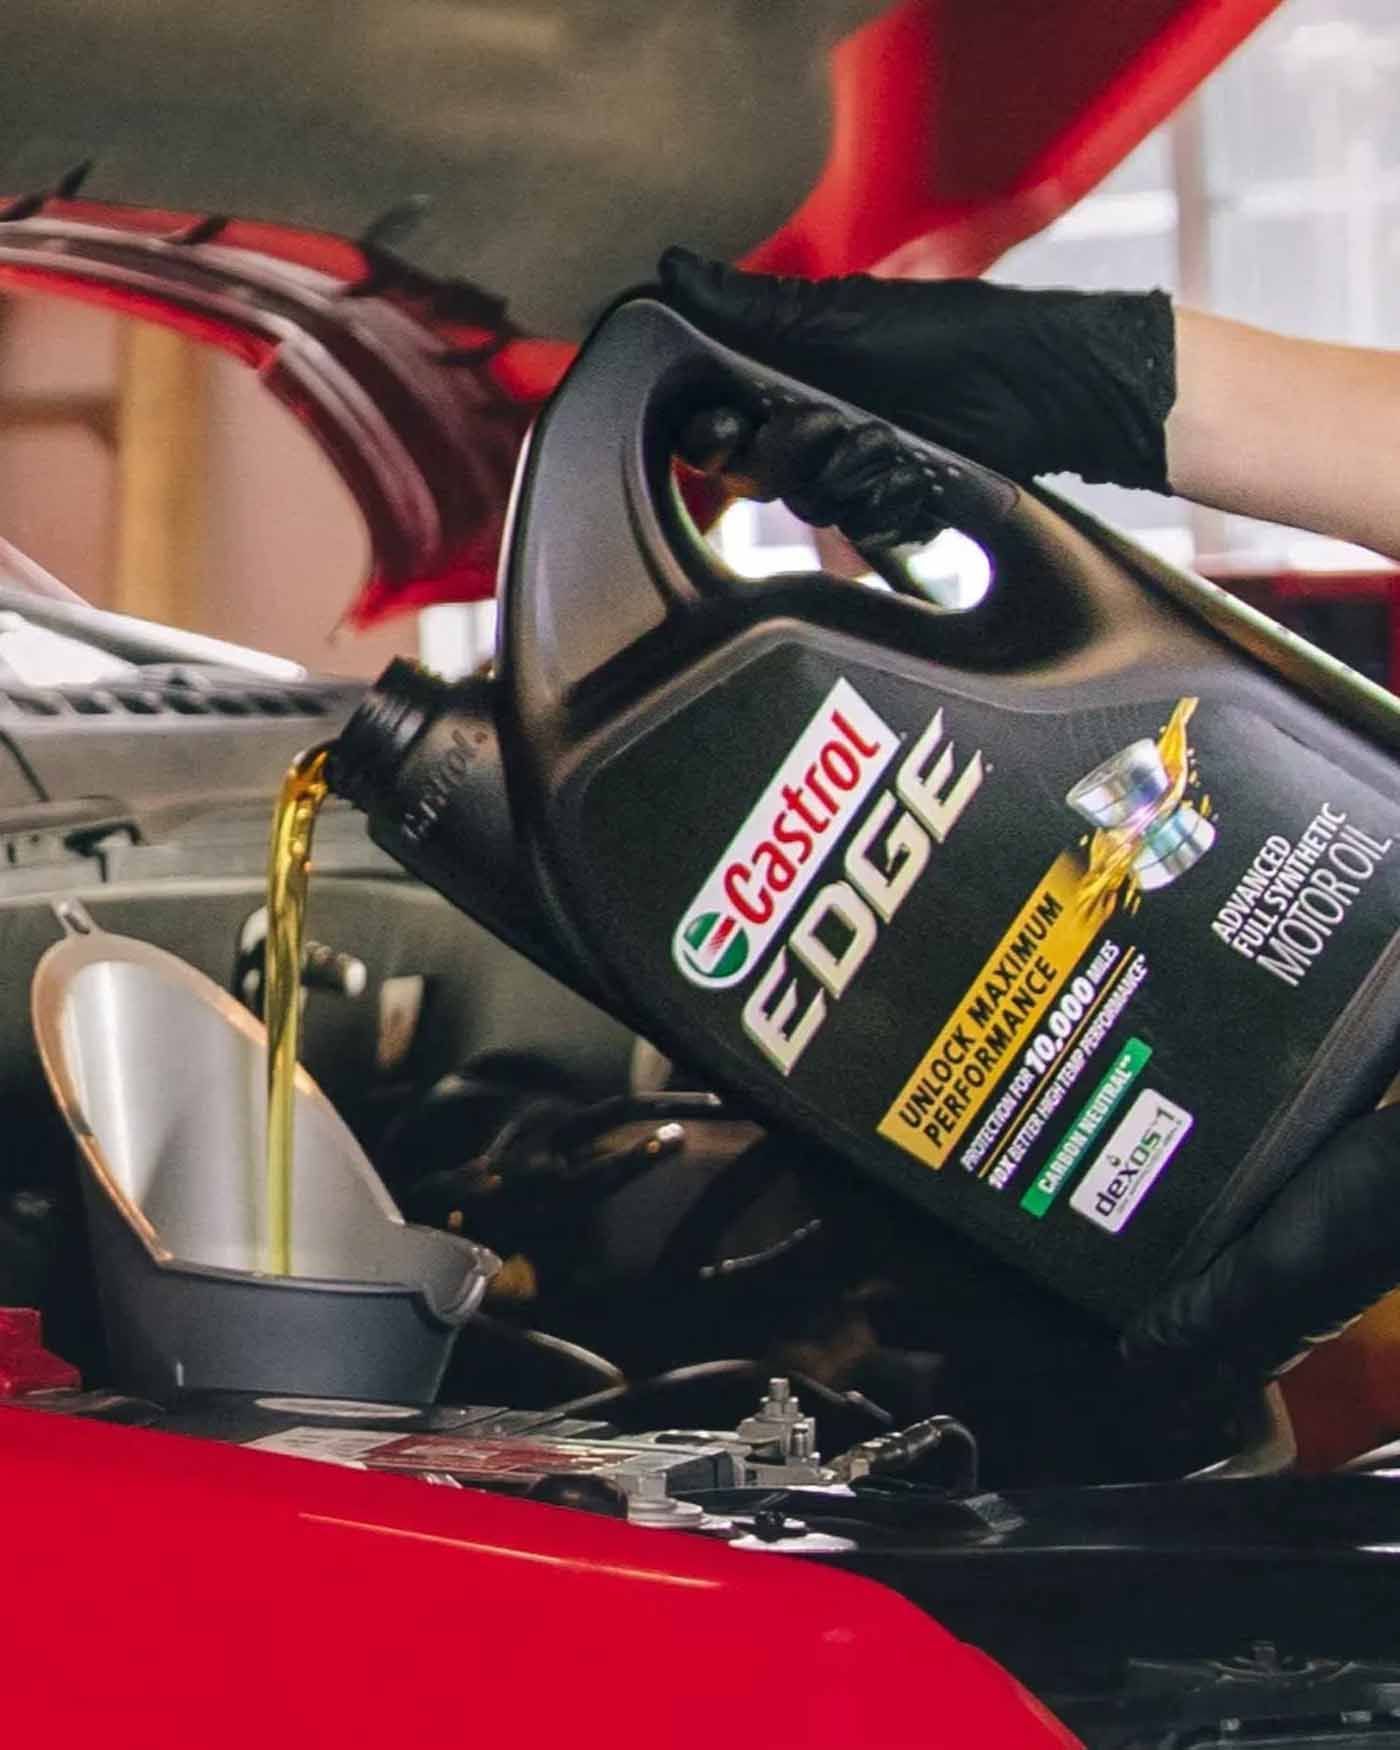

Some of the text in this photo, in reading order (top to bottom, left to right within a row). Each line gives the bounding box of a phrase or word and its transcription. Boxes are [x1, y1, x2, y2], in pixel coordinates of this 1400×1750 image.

[723, 709, 880, 925] Castrol
[741, 706, 984, 1077] EDGE
[1211, 835, 1291, 944] ADVANCED
[1232, 802, 1347, 958] FULL SYNTHETIC
[1256, 825, 1393, 986] MOTOR OIL
[898, 891, 1064, 1128] UNLOCK MAXIMUM
[923, 956, 1058, 1149] PERFORMANCE
[960, 939, 1120, 1171] PROTECTION FOR 10,000 MILES
[1010, 1113, 1045, 1168] BETTER
[1036, 1084, 1067, 1120] HIGH
[1055, 1048, 1086, 1088] TEMP
[1037, 1130, 1088, 1194] CARBON
